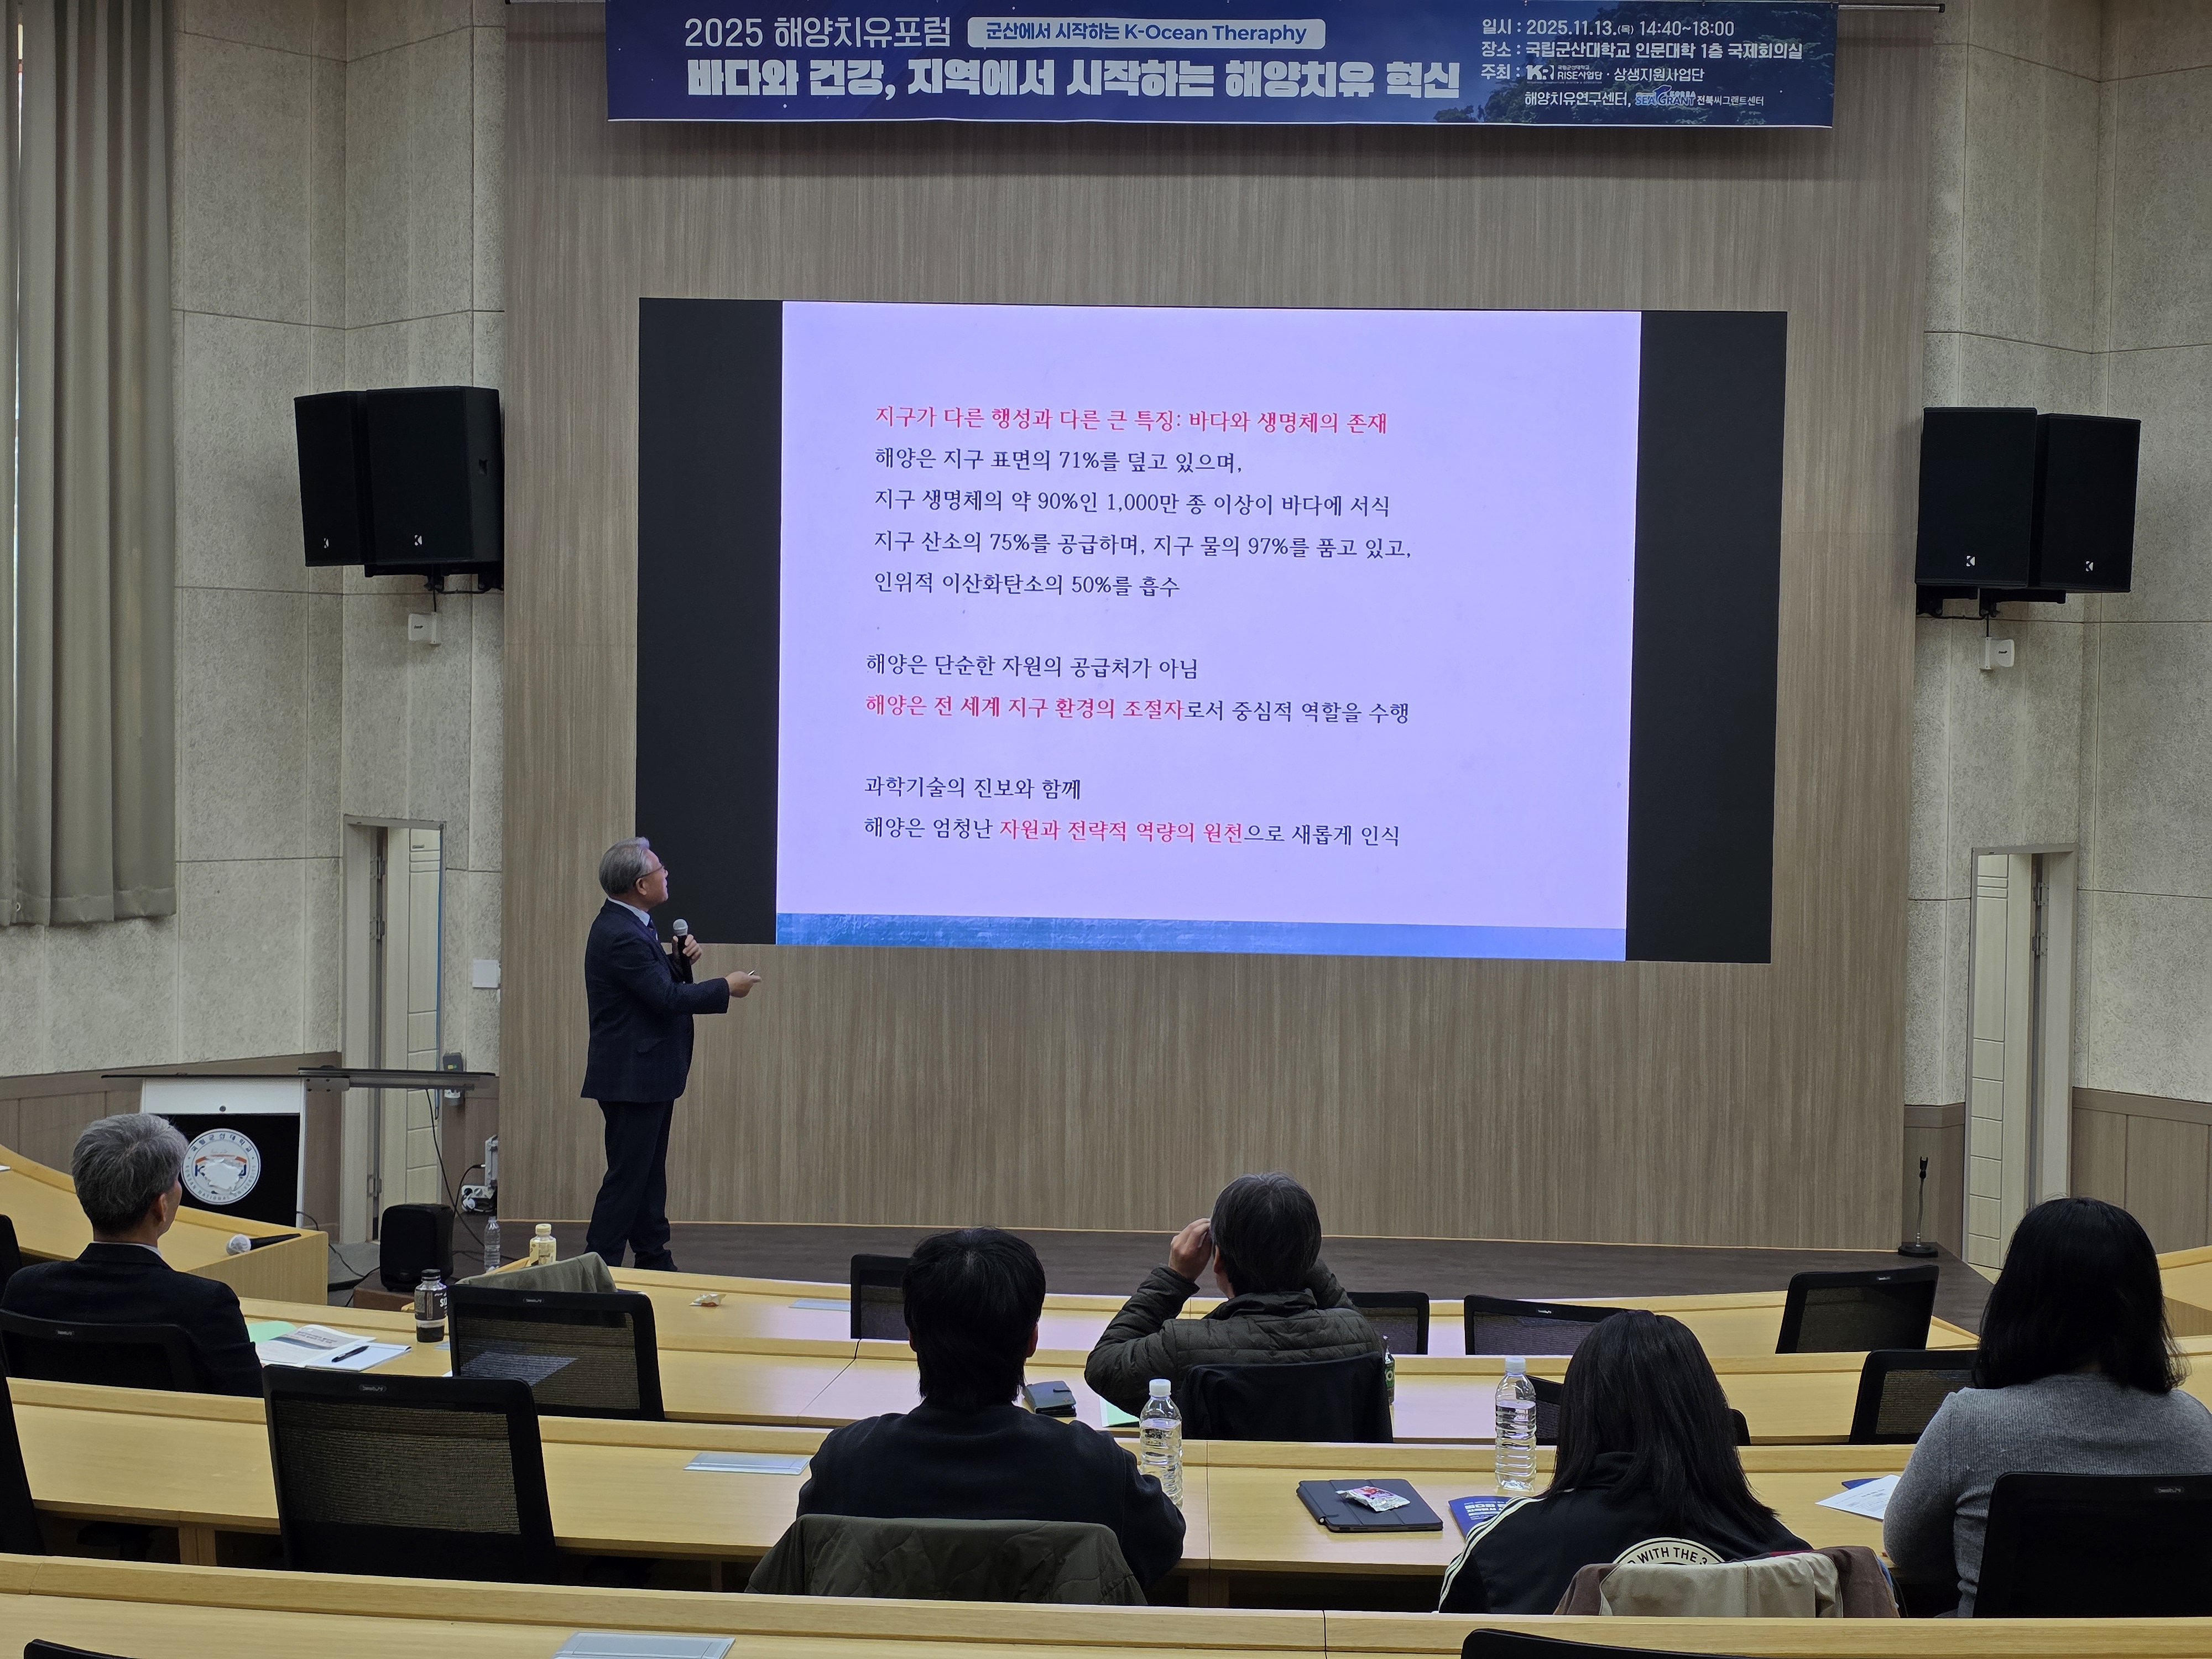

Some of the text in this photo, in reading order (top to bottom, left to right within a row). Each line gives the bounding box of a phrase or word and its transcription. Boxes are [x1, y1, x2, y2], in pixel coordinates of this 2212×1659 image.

[685, 17, 950, 48] 2025 해양치유포럼
[986, 22, 1307, 45] 군산에서 시작하는 K-Ocean Theraphy
[1482, 18, 1511, 35] 일시
[1640, 20, 1734, 36] 14:40~18:00
[1481, 41, 1511, 57] 장소
[1525, 41, 1631, 58] 국립군산대학교
[1635, 43, 1696, 59] 인문대학
[1700, 43, 1723, 59] 1층
[1728, 43, 1803, 60] 국제회의실
[687, 58, 1460, 101] 바다와 건강, 지역에서 시작하는 해양치유 혁신
[1481, 65, 1512, 80] 주최
[1558, 71, 1603, 80] RISE사업단
[1614, 68, 1704, 82] 상생지원사업단
[1525, 92, 1631, 108] 해양치유연구센터,
[1697, 96, 1764, 106] 전북씨그랜트센터
[876, 405, 1386, 434] 지구가 다른 행성과 다른 큰 특징: 바다와 생명체의 존재
[875, 447, 1241, 474] 해양은 지구 표면의 71%를 덮고 있으며,
[875, 488, 1389, 518] 지구 생명체의 약 90%인 1,000만 종 이상이 바다에 서식
[874, 530, 1411, 559] 지구 산소의 75%를 공급하며, 지구 물의 97%를 품고 있고,
[875, 571, 1180, 598] 인위적 이산화탄소의 50%를 흡수
[867, 653, 1197, 680] 해양은 단순한 자원의 공급처가 아님
[865, 694, 1408, 724] 해양은 전 세계 지구 환경의 조절자로서 중심적 역할을 수행
[864, 775, 1081, 800] 과학기술의 진보와 함께
[864, 816, 1399, 847] 해양은 엄청난 자원과 전략적 역량의 원천으로 새롭게 인식
[1636, 1547, 1670, 1563] WITH
[1673, 1547, 1698, 1563] THE
